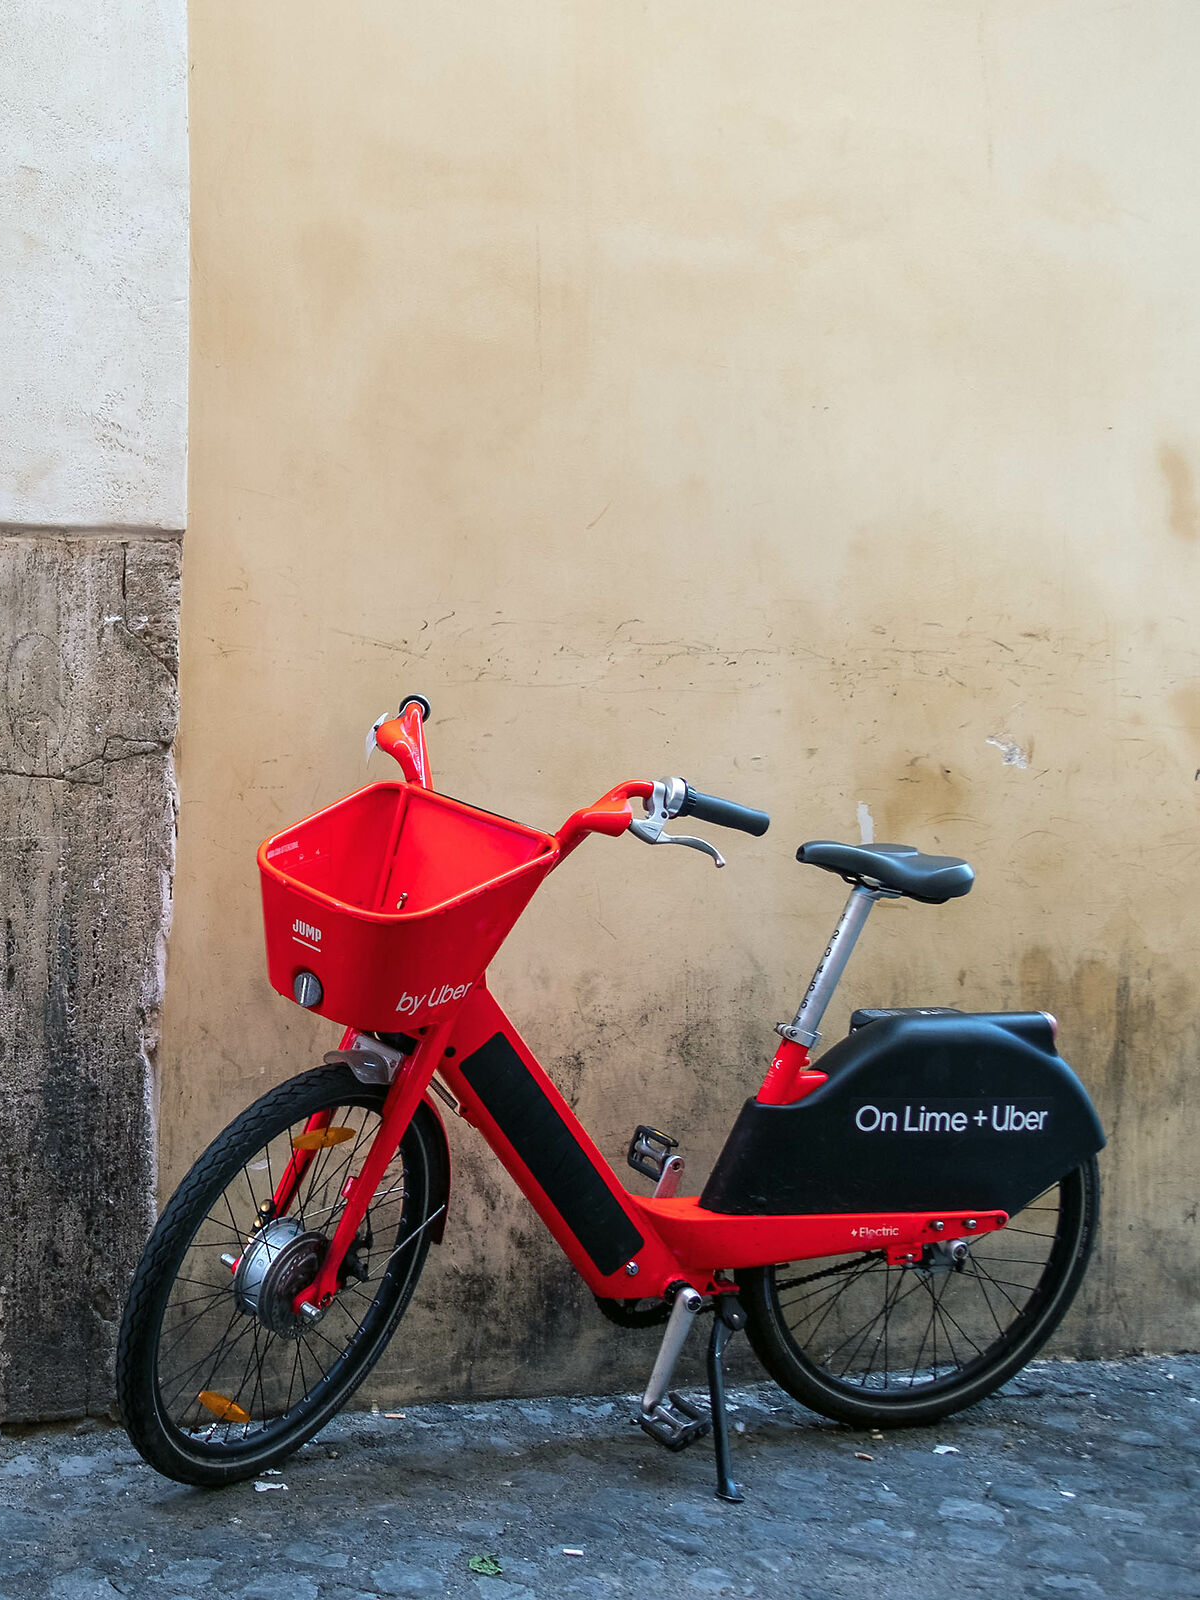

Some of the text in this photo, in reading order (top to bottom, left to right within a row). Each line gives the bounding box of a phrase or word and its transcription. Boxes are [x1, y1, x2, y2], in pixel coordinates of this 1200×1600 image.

[292, 919, 322, 942] JUMP
[832, 929, 840, 940] 2
[824, 946, 832, 957] 3
[816, 964, 824, 974] 4
[808, 981, 817, 992] 5
[395, 982, 473, 1016] by Uber
[800, 998, 809, 1009] 6
[855, 1105, 1049, 1132] On Lime + Uber
